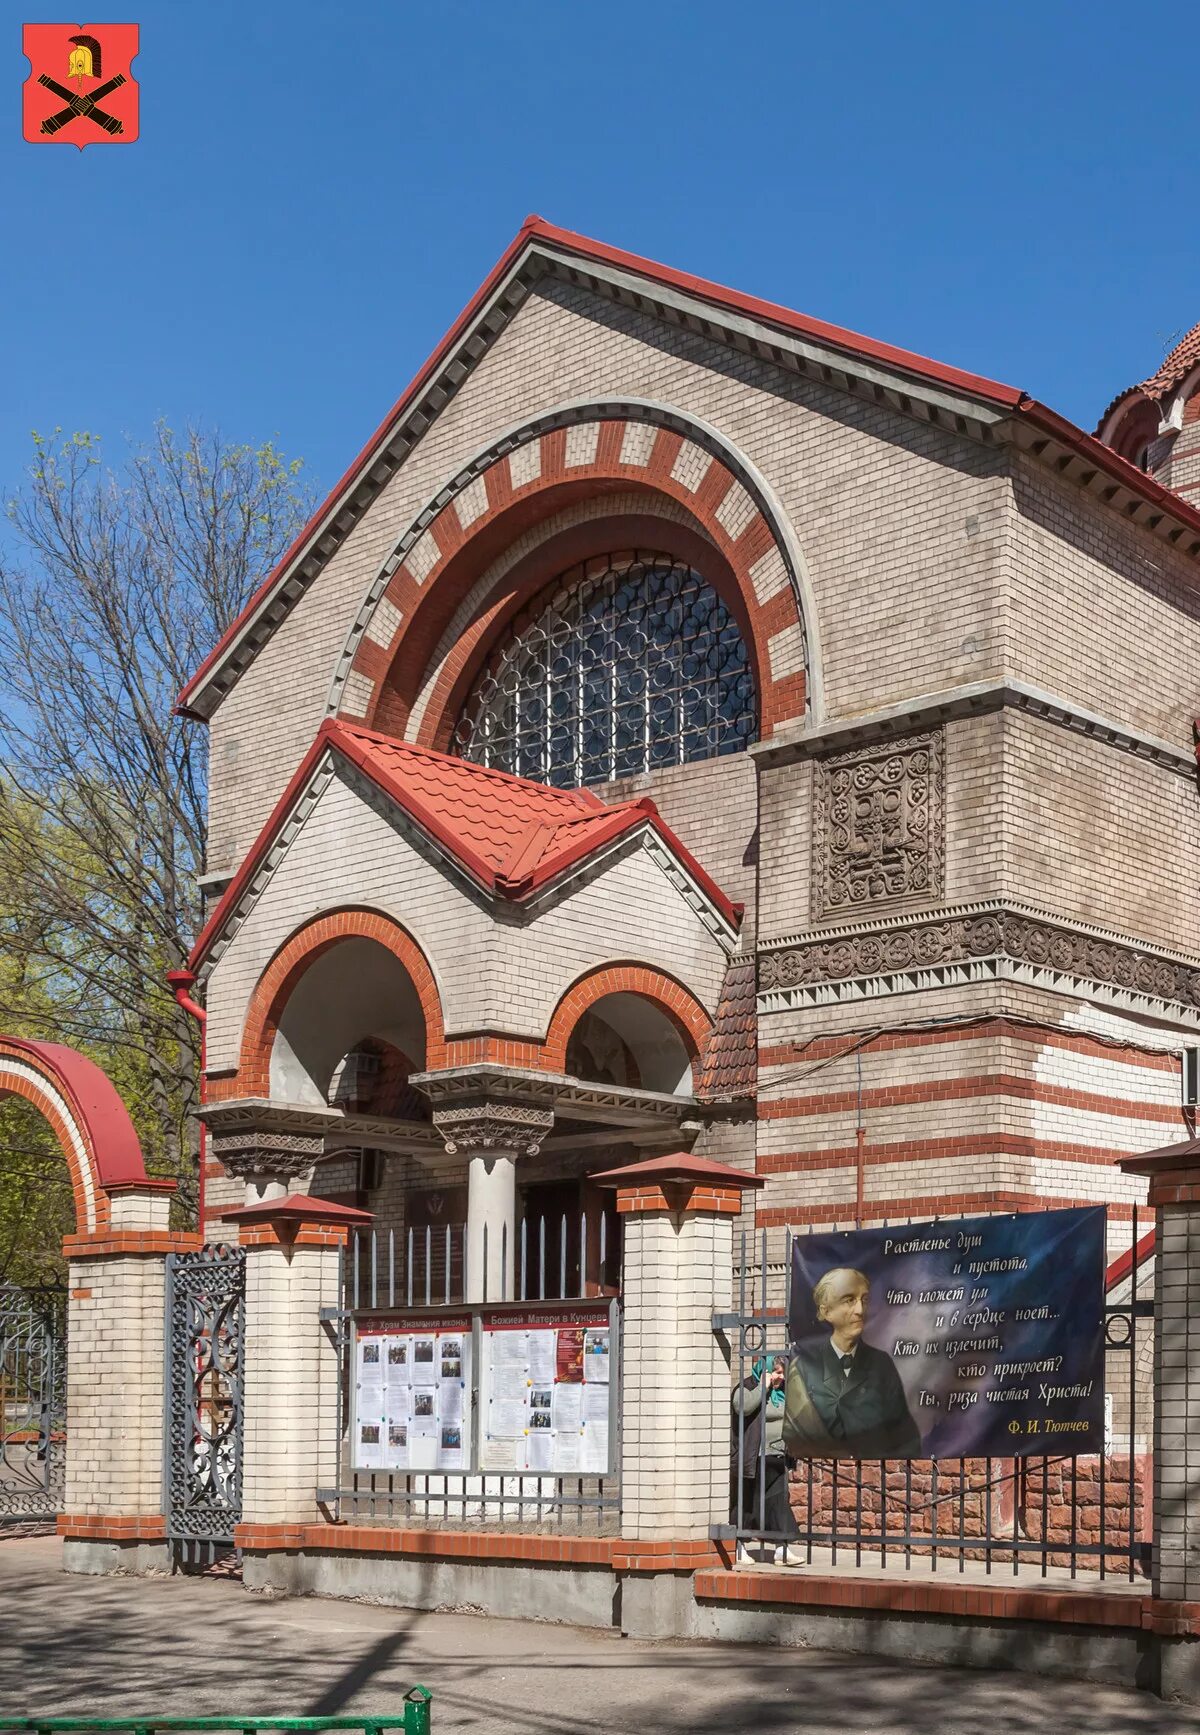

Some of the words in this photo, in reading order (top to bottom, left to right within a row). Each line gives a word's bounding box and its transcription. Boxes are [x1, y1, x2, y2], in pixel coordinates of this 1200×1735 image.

[884, 1237, 951, 1255] Растленье
[957, 1231, 982, 1256] душ
[953, 1263, 961, 1275] и
[968, 1256, 1028, 1280] пустота,
[886, 1289, 911, 1305] Что
[919, 1286, 964, 1303] гложет
[971, 1288, 988, 1307] ум
[380, 1321, 400, 1329] Храм
[442, 1319, 468, 1327] иконы
[491, 1315, 523, 1324] Божией
[528, 1314, 560, 1324] Матери
[935, 1316, 943, 1327] и
[950, 1310, 959, 1327] в
[963, 1307, 1005, 1331] сердце
[1016, 1305, 1060, 1321] ноет...
[893, 1340, 919, 1356] Кто
[926, 1341, 938, 1354] их
[945, 1335, 1003, 1359] излечит,
[958, 1363, 986, 1377] кто
[993, 1355, 1063, 1382] прикроет?
[919, 1389, 940, 1407] Ты,
[948, 1390, 978, 1410] риза
[986, 1384, 1029, 1401] чистая
[1038, 1380, 1093, 1406] Христа!
[1008, 1422, 1024, 1434] Ф.
[1027, 1420, 1041, 1433] И.
[1045, 1418, 1089, 1433] Тютчев
